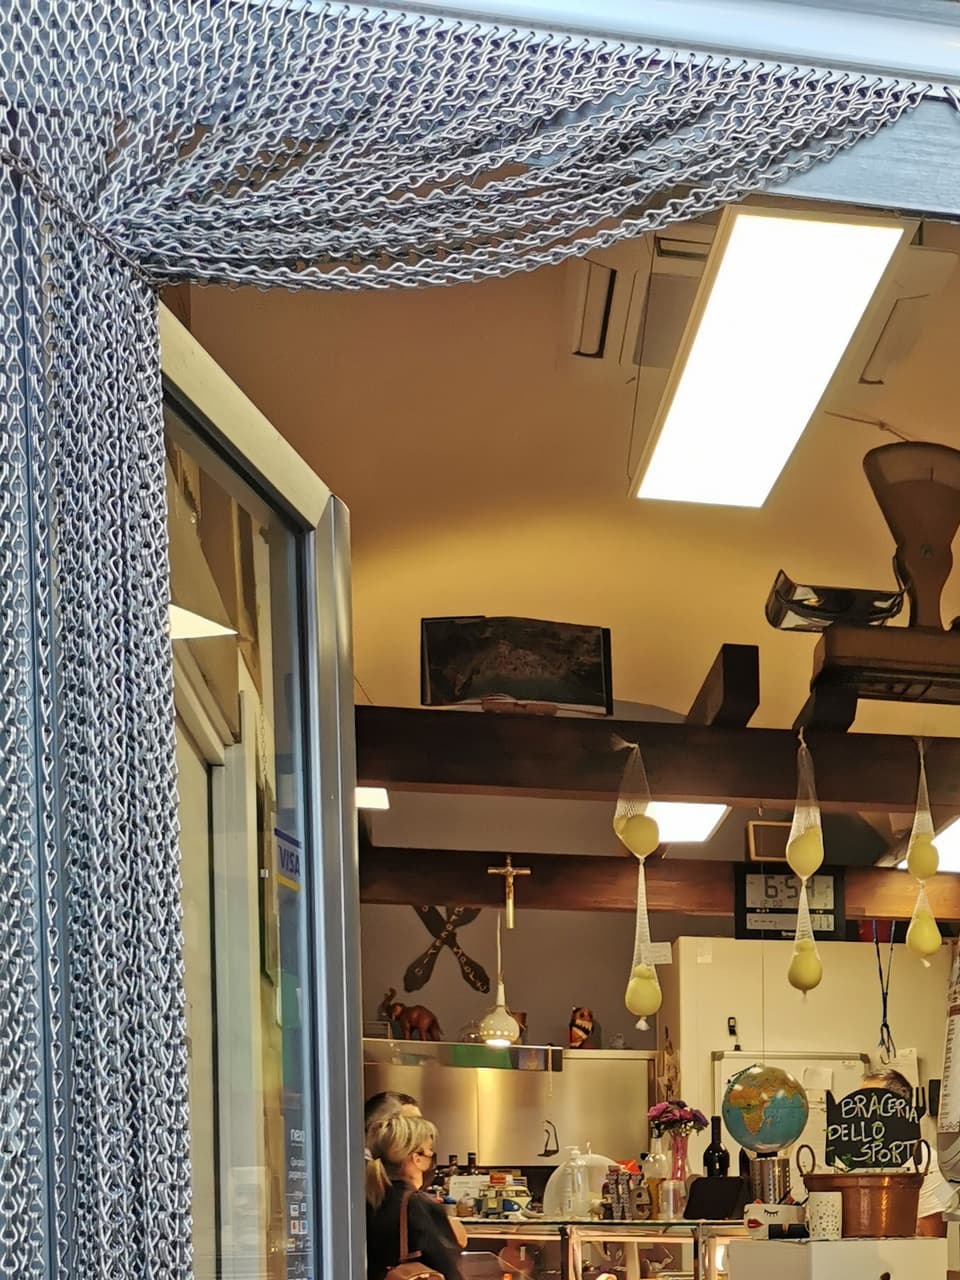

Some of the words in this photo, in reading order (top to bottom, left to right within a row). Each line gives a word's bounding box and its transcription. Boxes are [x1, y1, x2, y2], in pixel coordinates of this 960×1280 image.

[277, 844, 301, 877] VISA
[841, 1093, 918, 1124] BRACERIA
[828, 1121, 885, 1142] DELLO
[852, 1140, 918, 1163] SPORT
